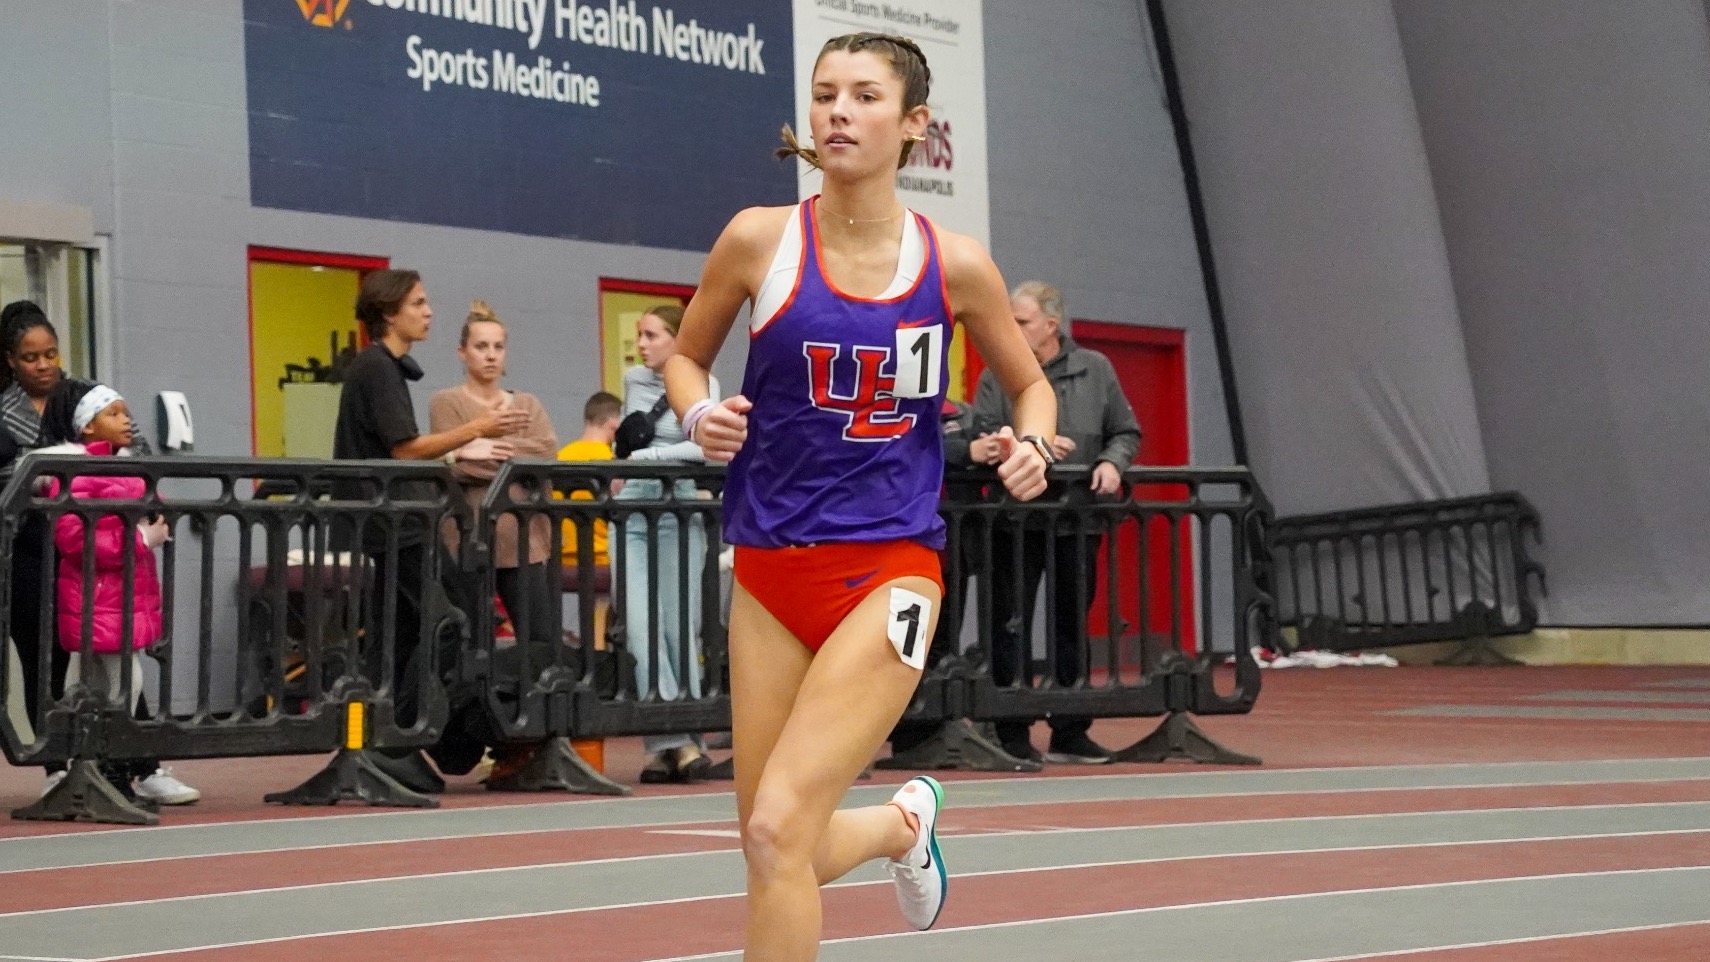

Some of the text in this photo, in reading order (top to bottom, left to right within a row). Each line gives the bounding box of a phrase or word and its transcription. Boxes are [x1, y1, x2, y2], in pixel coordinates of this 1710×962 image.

[366, 0, 766, 75] unity Health Network
[405, 34, 601, 107] Sports Medicine
[803, 341, 917, 443] UE
[910, 331, 932, 395] 1
[896, 602, 922, 659] 1
